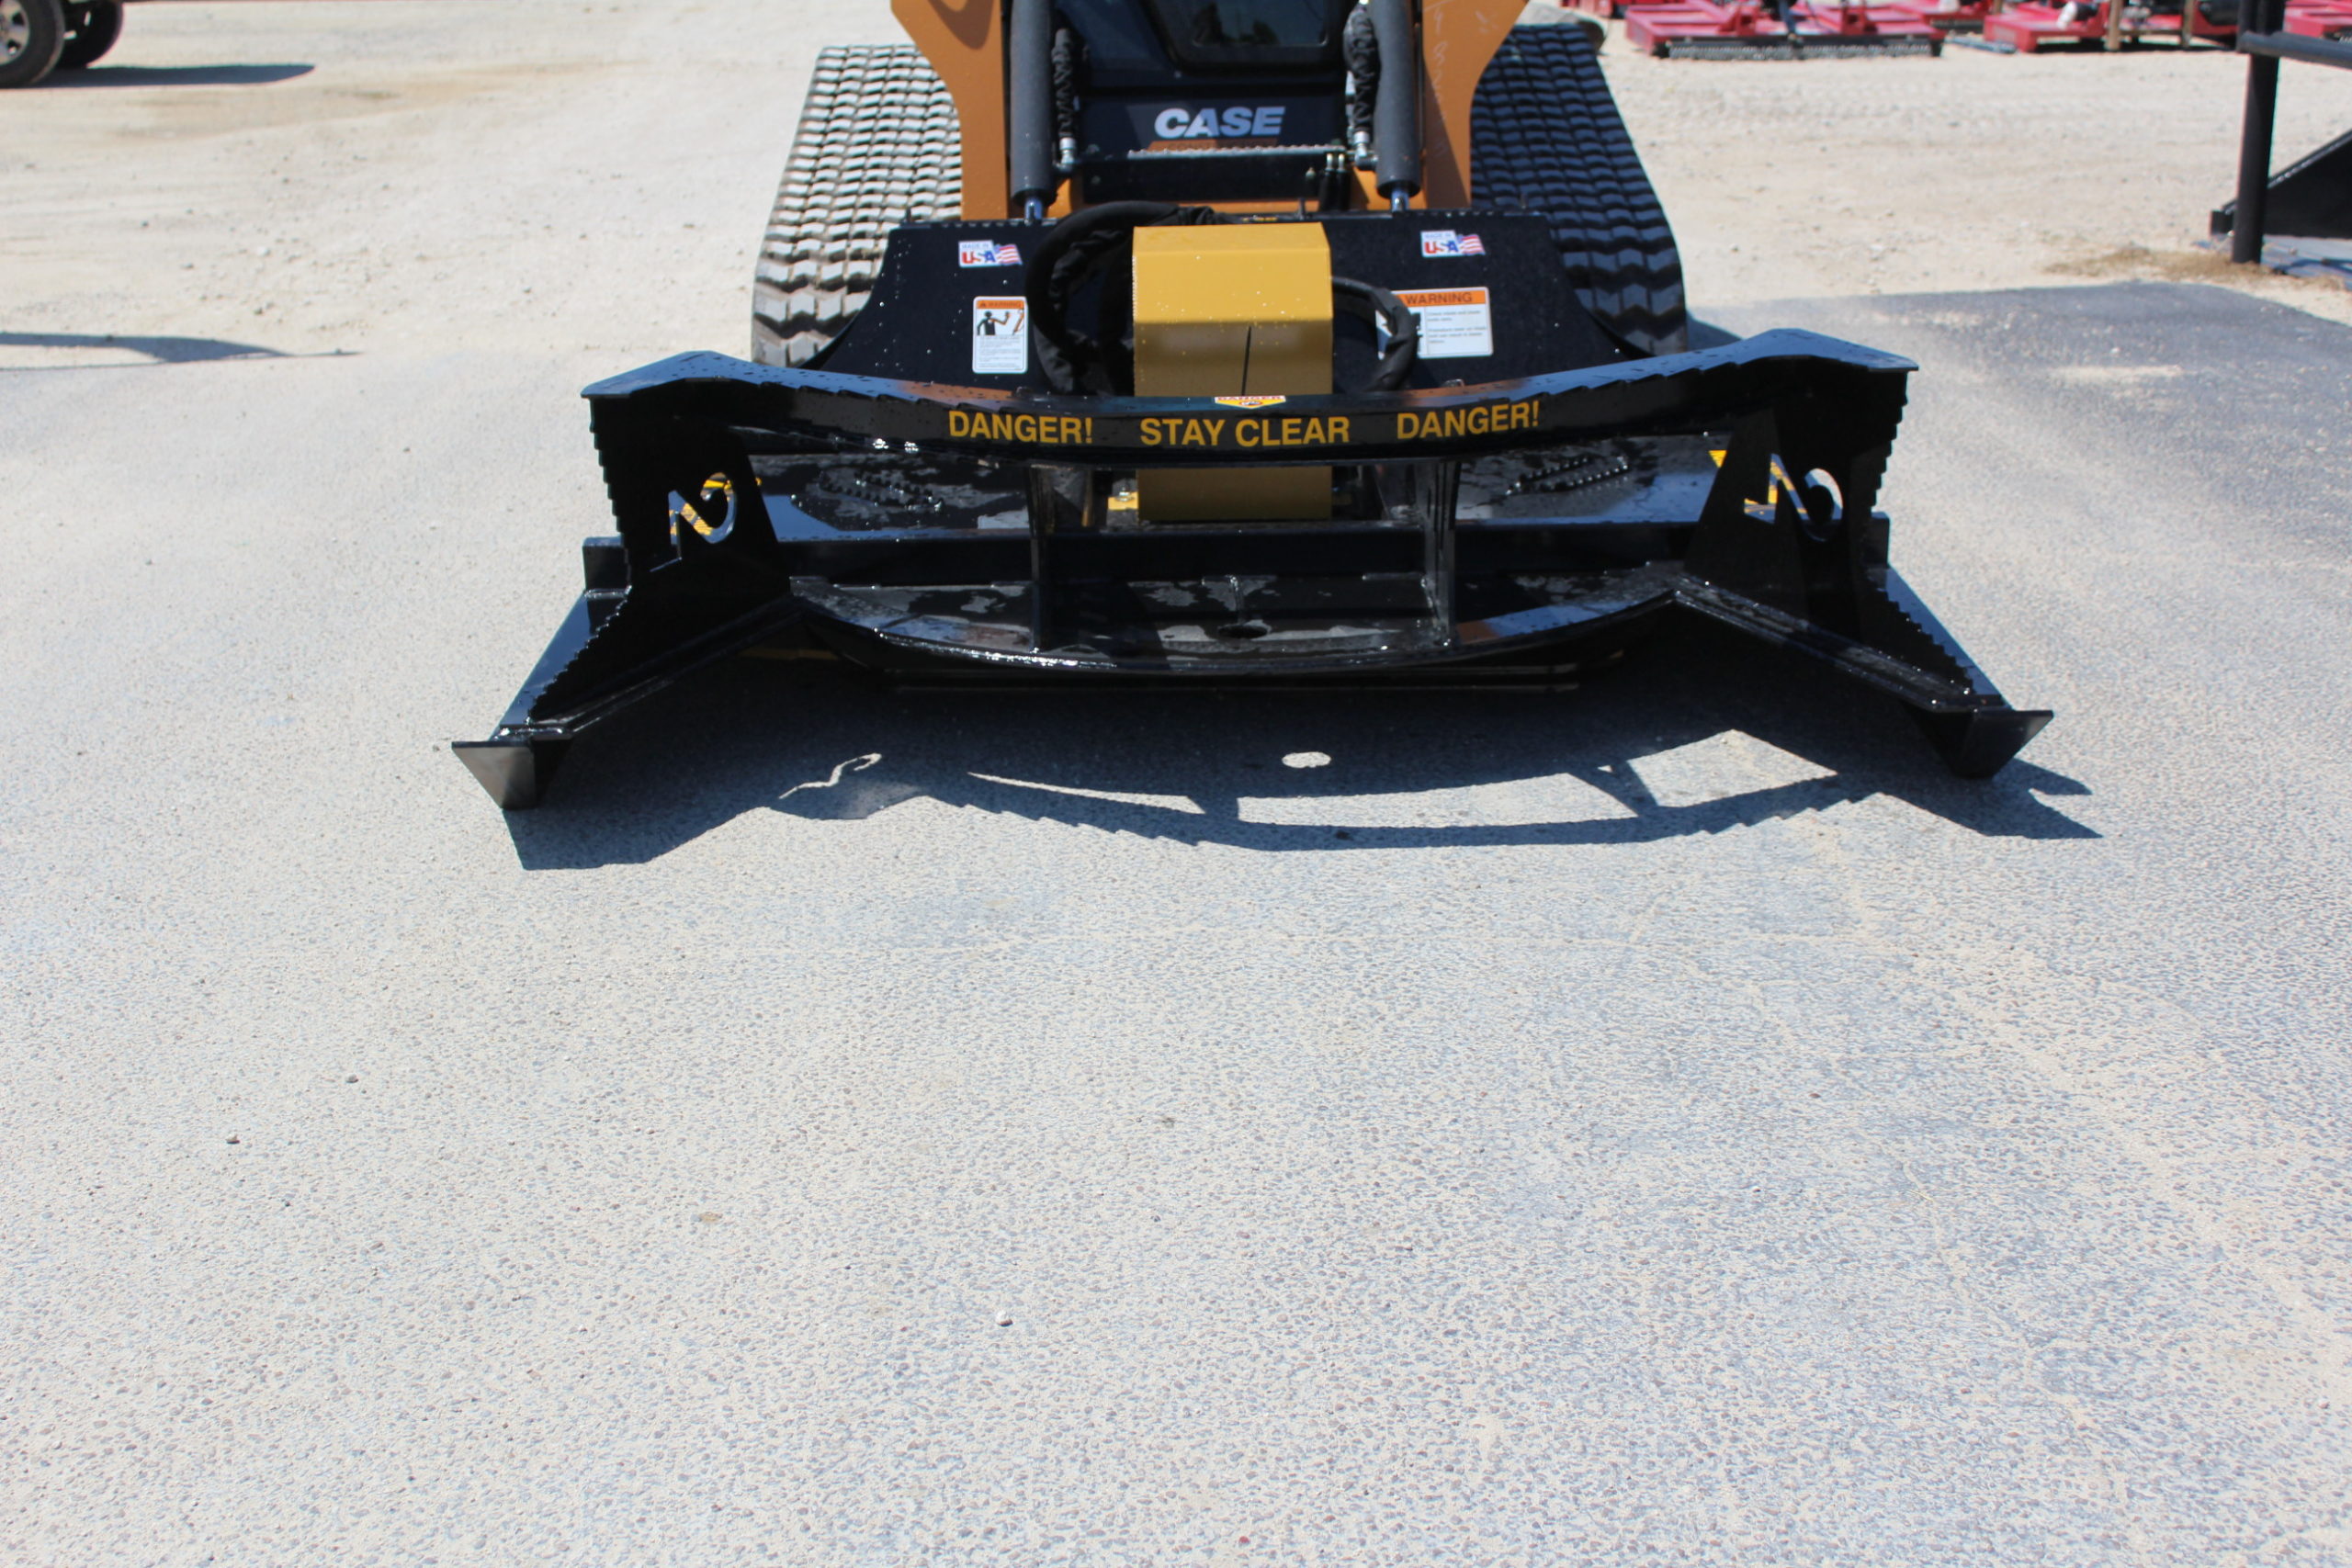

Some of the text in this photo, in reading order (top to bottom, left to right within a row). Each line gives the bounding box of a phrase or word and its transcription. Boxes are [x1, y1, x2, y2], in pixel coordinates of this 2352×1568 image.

[1154, 107, 1285, 139] CASE
[1424, 241, 1459, 254] USA
[961, 251, 996, 265] USA
[1405, 291, 1473, 304] WARNING
[949, 400, 1541, 447] DANGER! STAY CLEAR DANGER!
